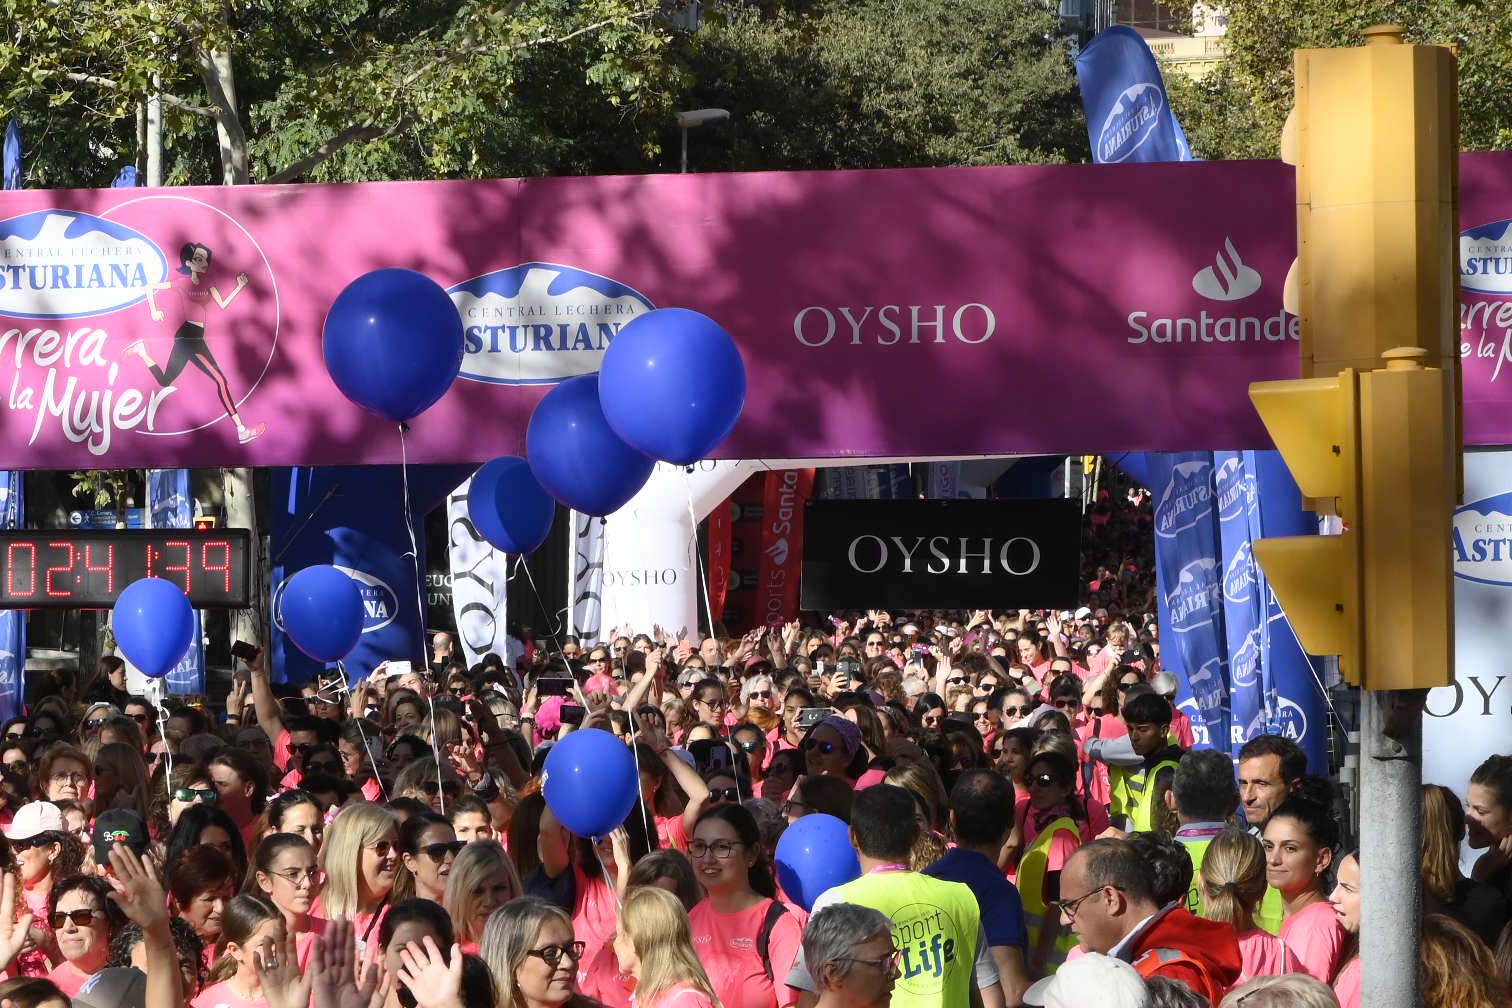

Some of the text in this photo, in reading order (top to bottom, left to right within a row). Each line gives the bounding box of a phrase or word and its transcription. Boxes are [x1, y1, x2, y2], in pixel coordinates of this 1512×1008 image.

[468, 303, 636, 318] CENTRAL LECHERA
[793, 303, 996, 347] OYSHO
[1127, 309, 1301, 344] Santande
[464, 322, 621, 354] STURIAN
[8, 371, 34, 411] la
[28, 361, 178, 456] Mujer
[772, 471, 799, 534] Santa
[847, 534, 1041, 576] OYSHO
[602, 567, 678, 587] OYSHO
[1423, 674, 1512, 718] OY
[903, 933, 955, 980] Life
